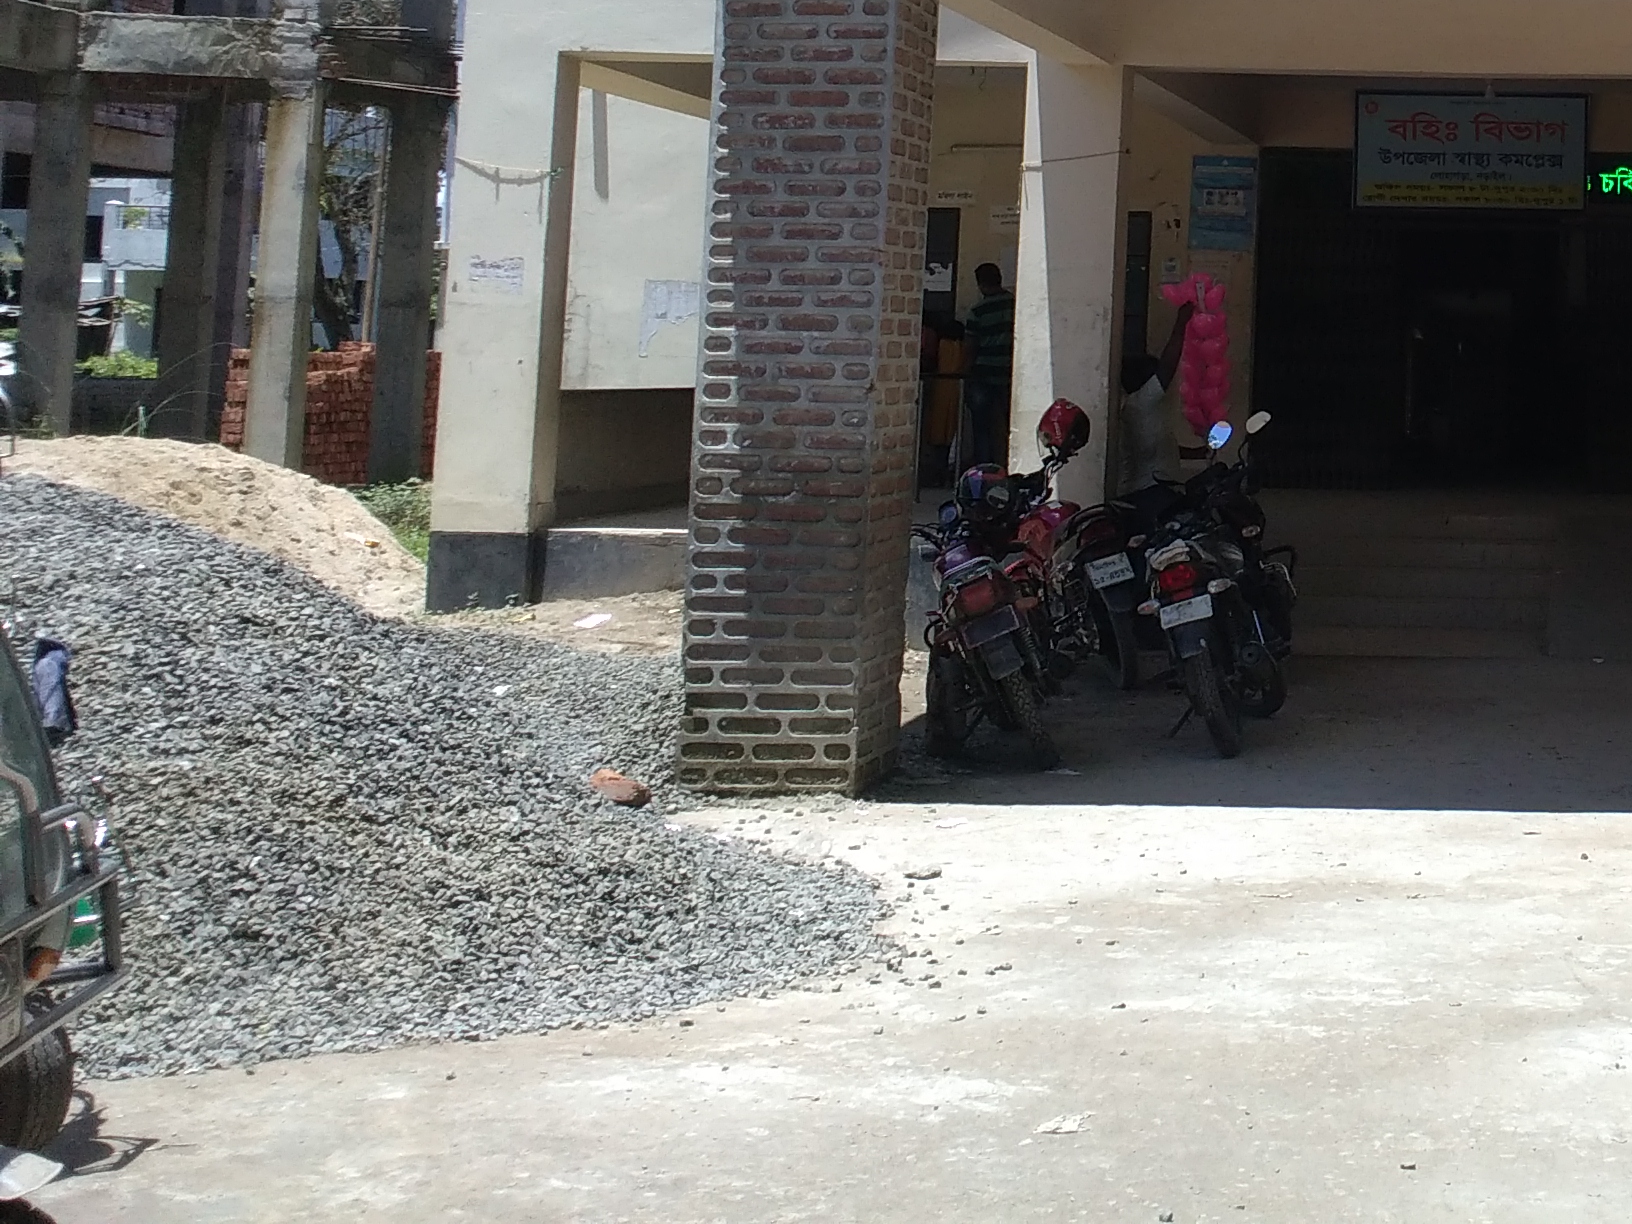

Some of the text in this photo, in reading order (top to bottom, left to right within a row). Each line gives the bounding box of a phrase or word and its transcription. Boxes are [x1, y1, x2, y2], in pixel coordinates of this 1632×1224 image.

[1385, 111, 1569, 145] বহিঃ বিভাগ
[1378, 147, 1447, 168] উপজেলা
[1498, 152, 1565, 169] কমপ্লেক্স
